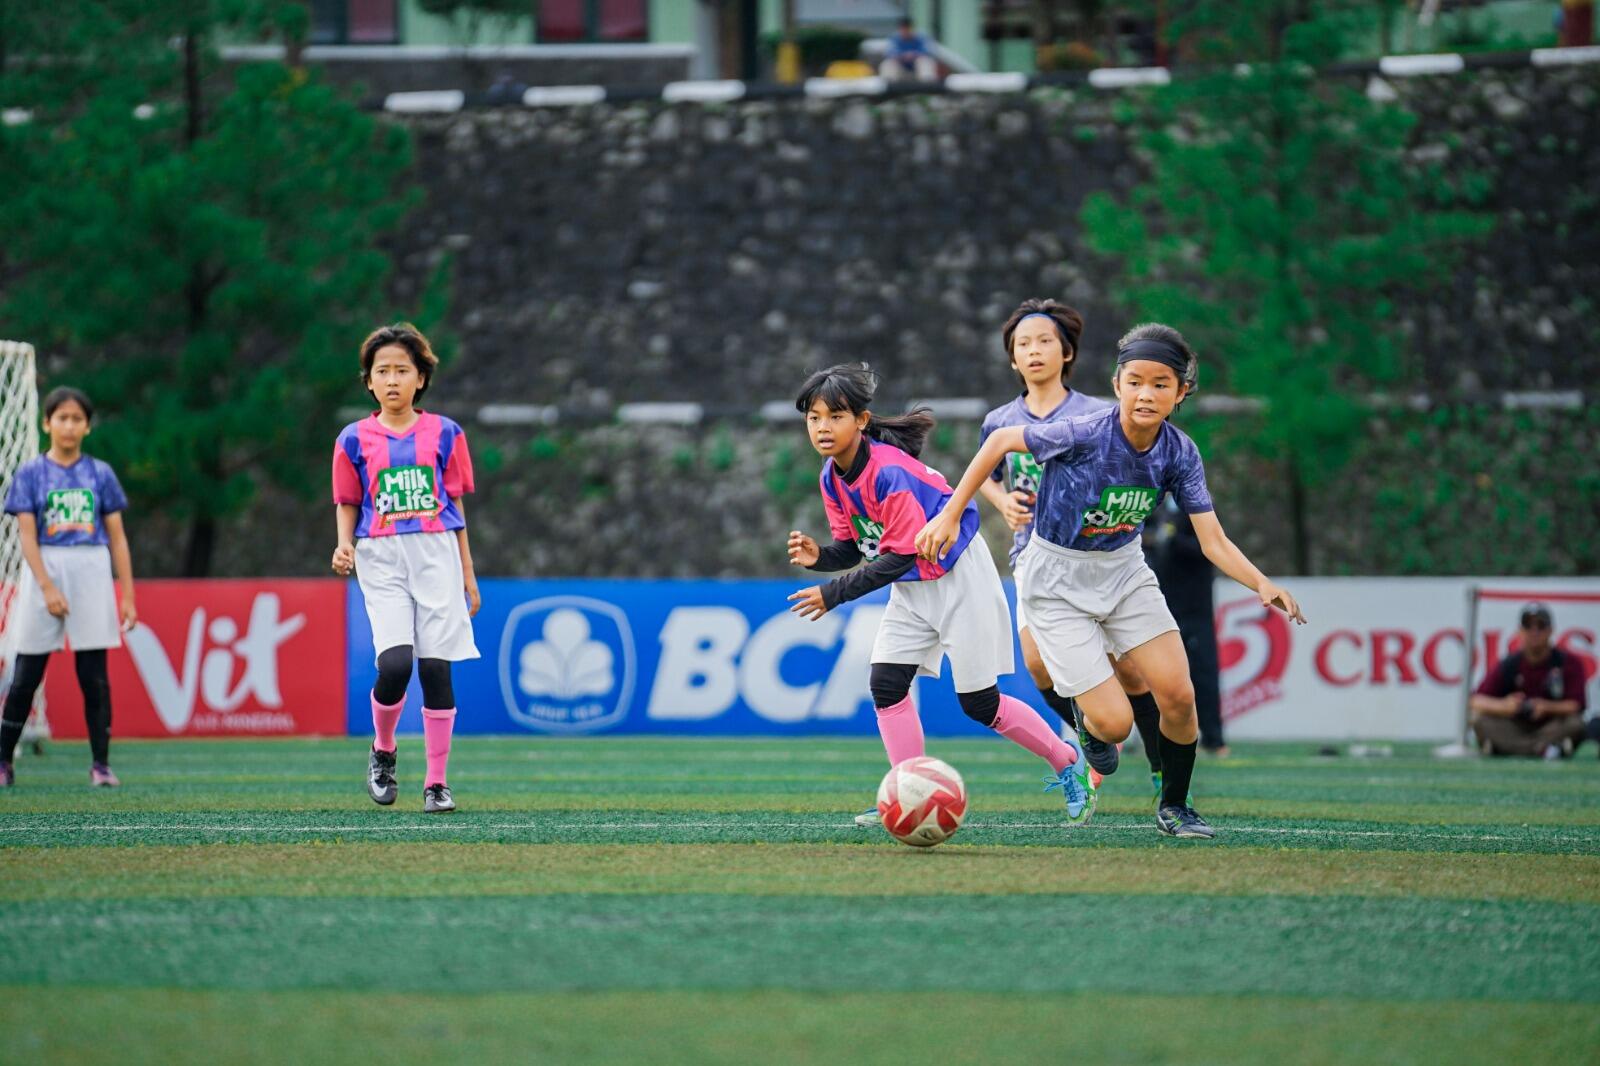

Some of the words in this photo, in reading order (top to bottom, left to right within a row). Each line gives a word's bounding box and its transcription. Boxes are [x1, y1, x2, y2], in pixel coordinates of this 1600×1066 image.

[384, 468, 430, 492] Milk
[393, 488, 435, 511] Life
[1106, 490, 1153, 511] Milk
[1106, 509, 1147, 527] Life
[124, 592, 306, 732] Vit
[1313, 628, 1599, 687] CROIS
